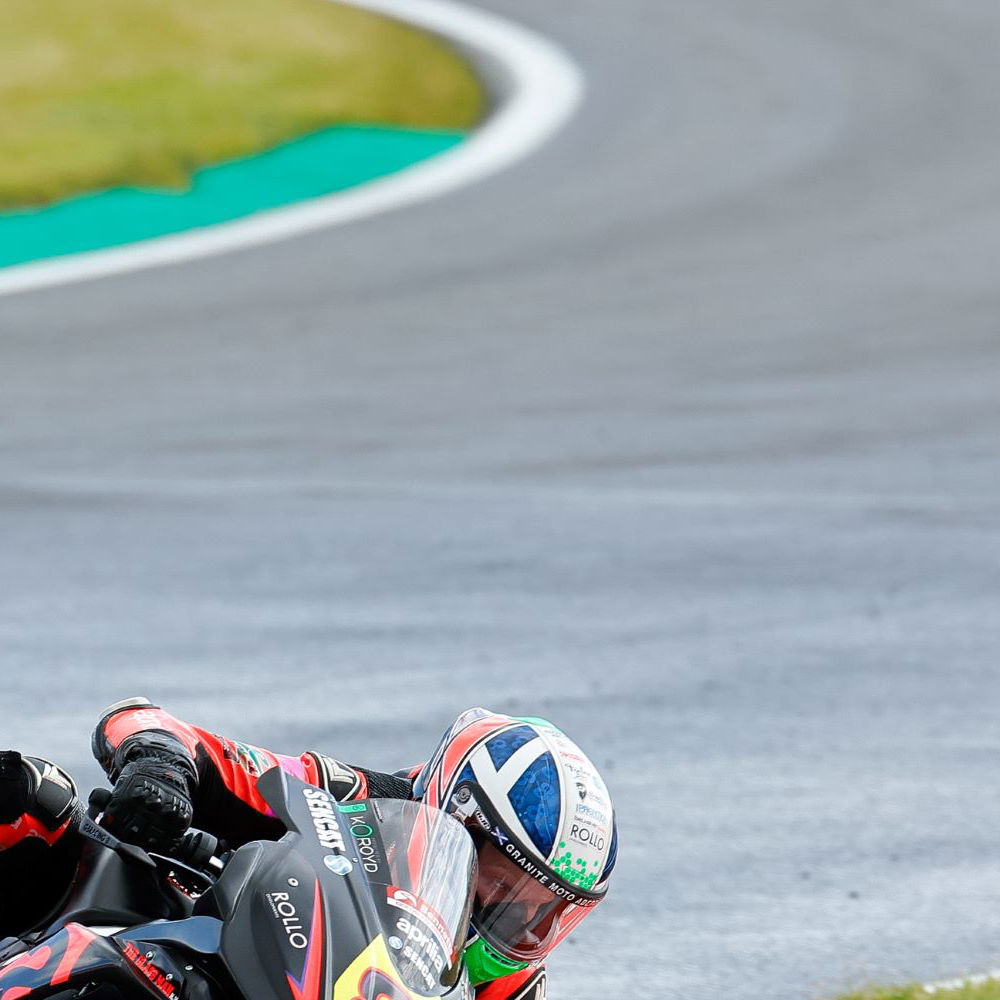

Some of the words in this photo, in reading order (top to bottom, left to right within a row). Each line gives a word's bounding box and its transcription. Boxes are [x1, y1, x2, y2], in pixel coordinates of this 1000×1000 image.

[303, 788, 346, 852] SENCAT
[349, 815, 379, 873] KOROYD
[570, 823, 605, 851] ROLLO
[505, 843, 549, 885] GRANITE
[548, 881, 576, 901] MOTO
[271, 892, 308, 949] ROLLO
[396, 917, 444, 974] aprilia
[122, 941, 140, 961] THE
[403, 945, 437, 990] SENCAT
